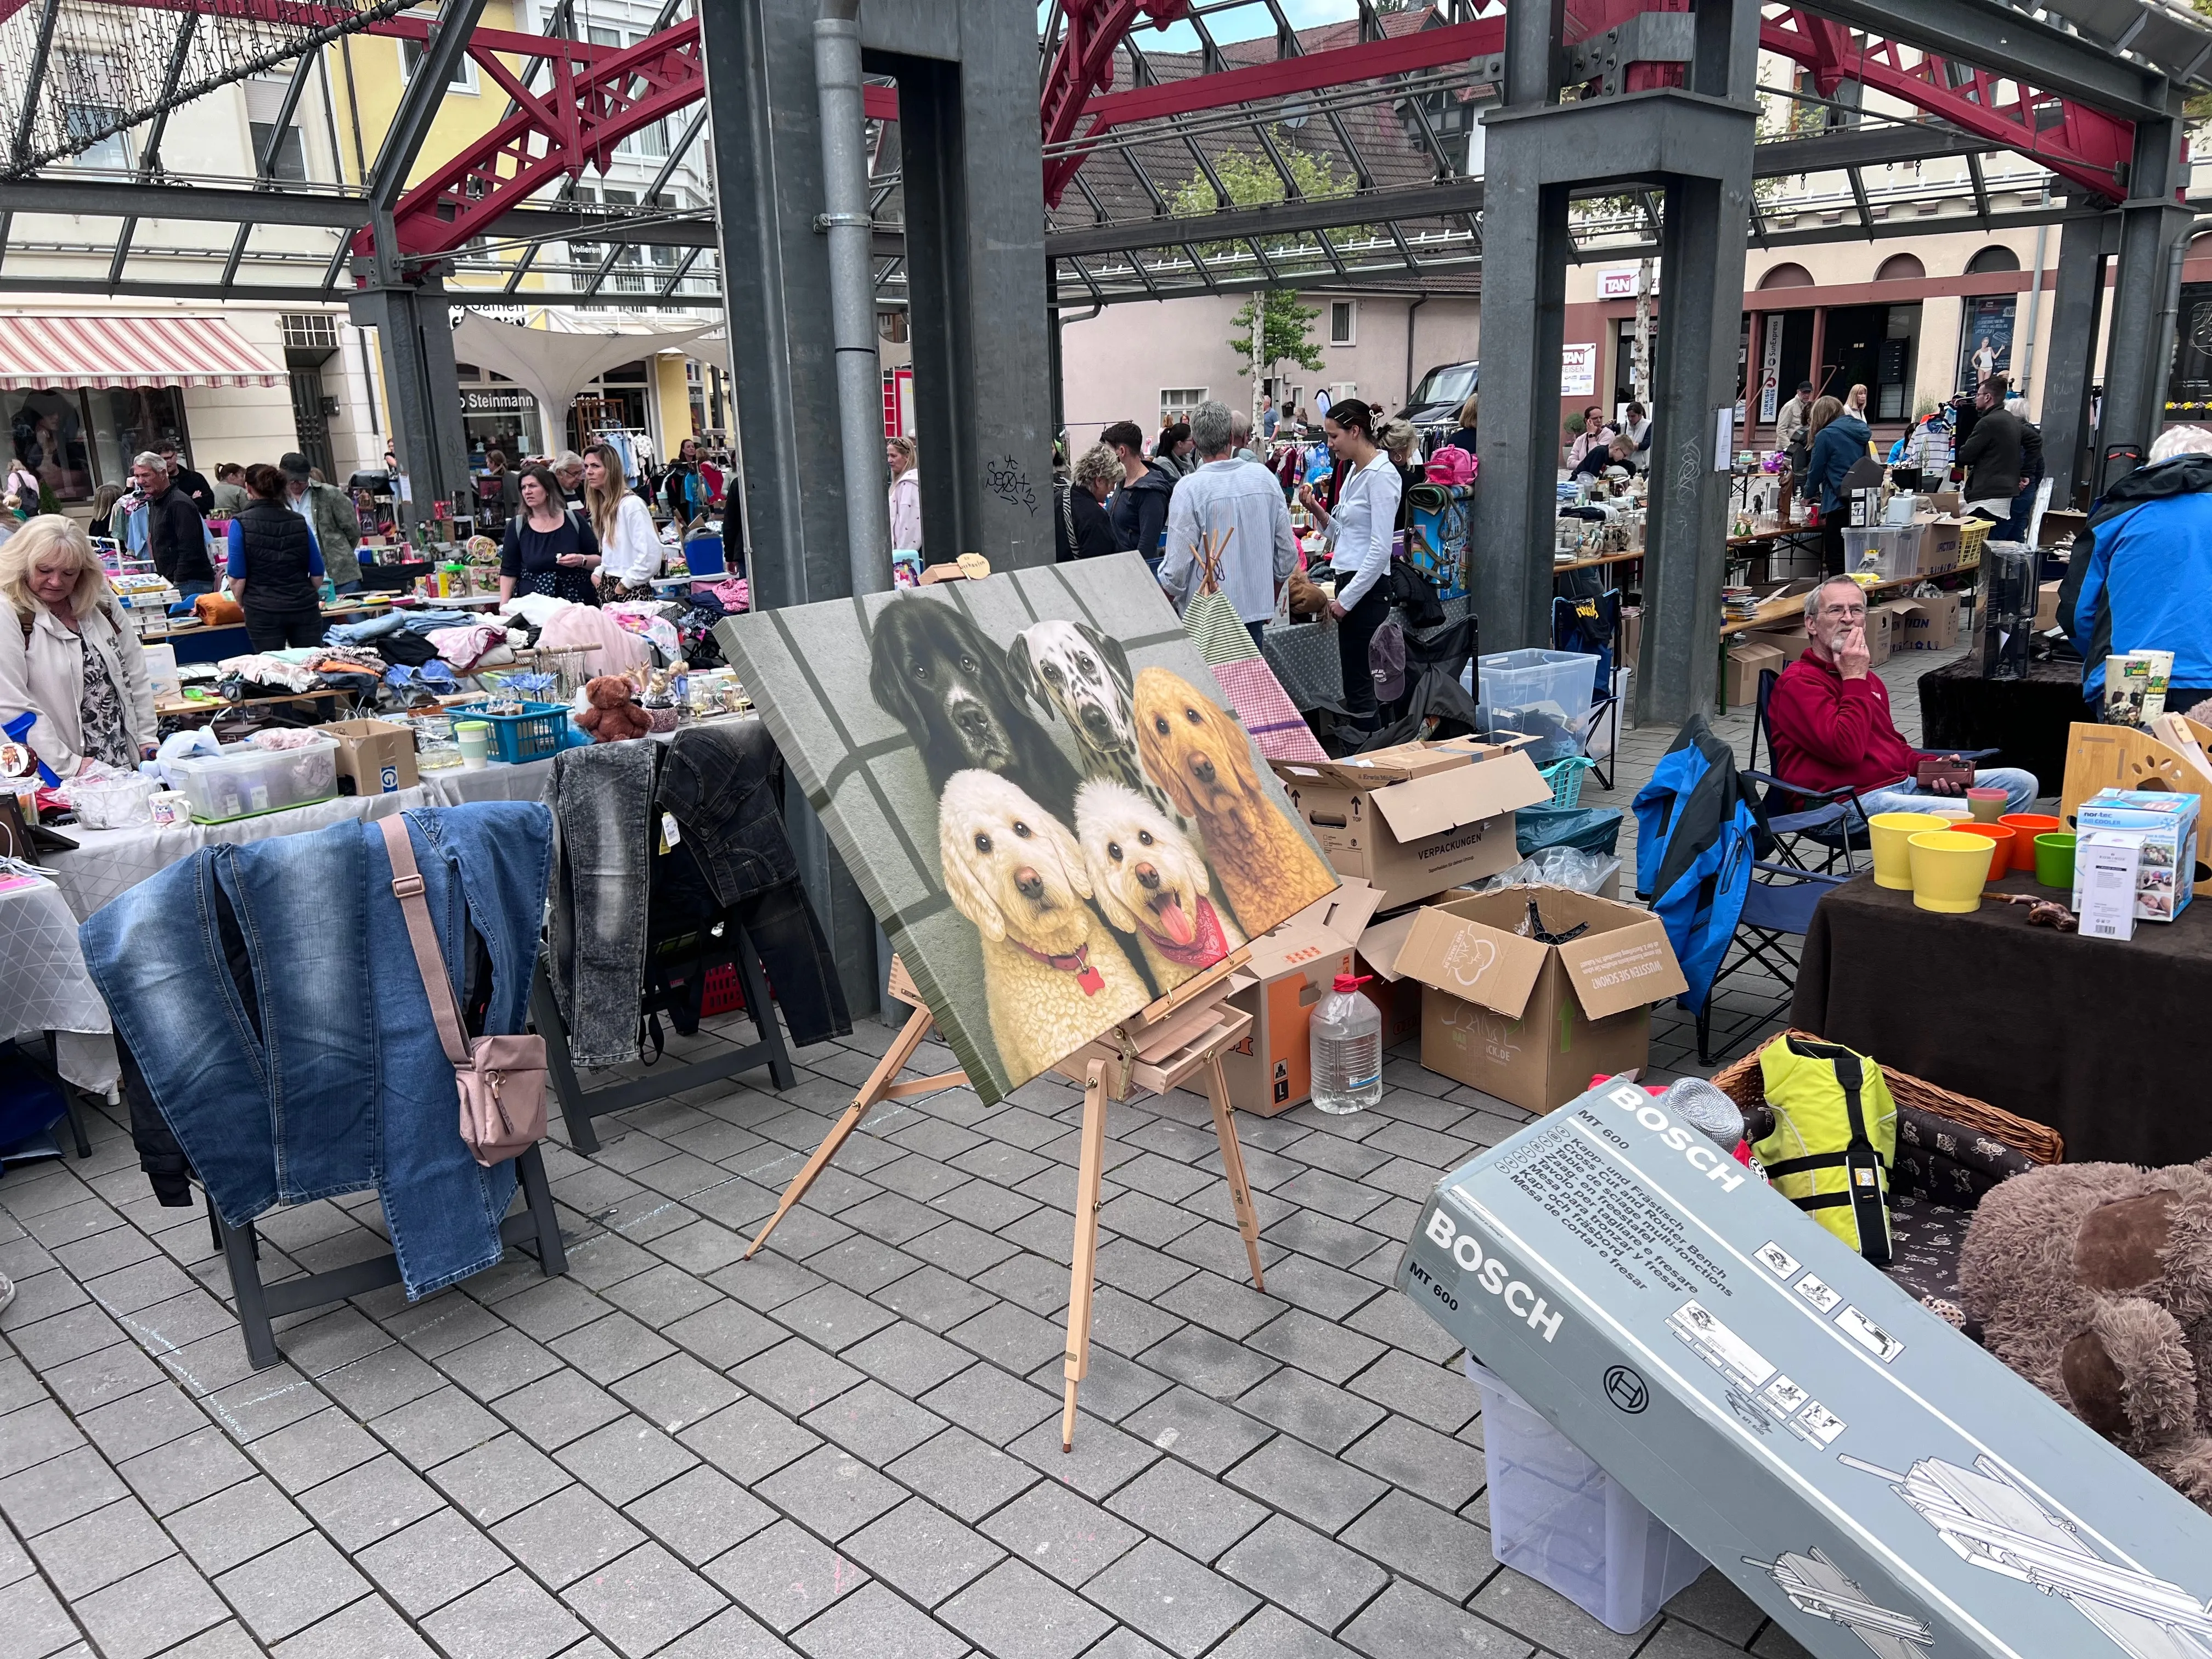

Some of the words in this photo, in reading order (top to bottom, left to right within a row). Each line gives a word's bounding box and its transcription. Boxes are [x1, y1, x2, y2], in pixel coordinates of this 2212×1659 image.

[1606, 278, 1629, 292] TAN
[1769, 321, 1778, 356] SunExpress
[1562, 351, 1584, 364] TAN
[469, 393, 533, 408] Steinmann
[1937, 541, 1956, 552] ACTION
[1905, 618, 1929, 628] TION
[1418, 833, 1481, 860] VERPACKUNGEN
[1592, 974, 1620, 989] SCHON?
[1619, 970, 1631, 981] SIE
[1629, 961, 1663, 979] WUSSTEN
[1279, 1084, 1284, 1096] L
[1578, 1109, 1604, 1127] MT
[1602, 1129, 1629, 1149] 600
[1607, 1086, 1746, 1193] BOSCH
[1544, 1153, 1579, 1180] Zaag-
[1580, 1182, 1596, 1195] en
[1597, 1195, 1657, 1244] freestafel
[1571, 1138, 1605, 1165] Kapp-
[1606, 1167, 1632, 1185] und
[1630, 1186, 1685, 1232] Frästisch
[1519, 1169, 1547, 1192] Kap-
[1548, 1194, 1571, 1212] och
[1572, 1213, 1624, 1257] fräsbord
[1528, 1164, 1560, 1191] Mesa
[1560, 1192, 1589, 1215] para
[1590, 1215, 1634, 1252] tronzar
[1632, 1252, 1644, 1261] y
[1644, 1260, 1683, 1292] fresar
[1538, 1158, 1574, 1189] Tavolo
[1573, 1190, 1597, 1207] per
[1597, 1208, 1642, 1246] tagliare
[1654, 1255, 1698, 1294] fresare
[1555, 1148, 1584, 1173] Table
[1586, 1173, 1602, 1187] de
[1602, 1188, 1641, 1220] sciage
[1642, 1221, 1733, 1297] multi-fonctions
[1563, 1144, 1596, 1170] Cross
[1598, 1171, 1620, 1189] Cut
[1620, 1190, 1645, 1209] and
[1644, 1209, 1687, 1245] Router
[1687, 1244, 1727, 1279] Bench
[1510, 1175, 1543, 1202] Mesa
[1544, 1203, 1560, 1217] de
[1561, 1218, 1599, 1249] cortar
[1609, 1258, 1647, 1290] fresar
[1409, 1262, 1432, 1285] MT
[1434, 1284, 1458, 1311] 600
[1425, 1207, 1564, 1343] BOSCH
[1742, 1416, 1752, 1424] MT
[1752, 1425, 1764, 1435] 600
